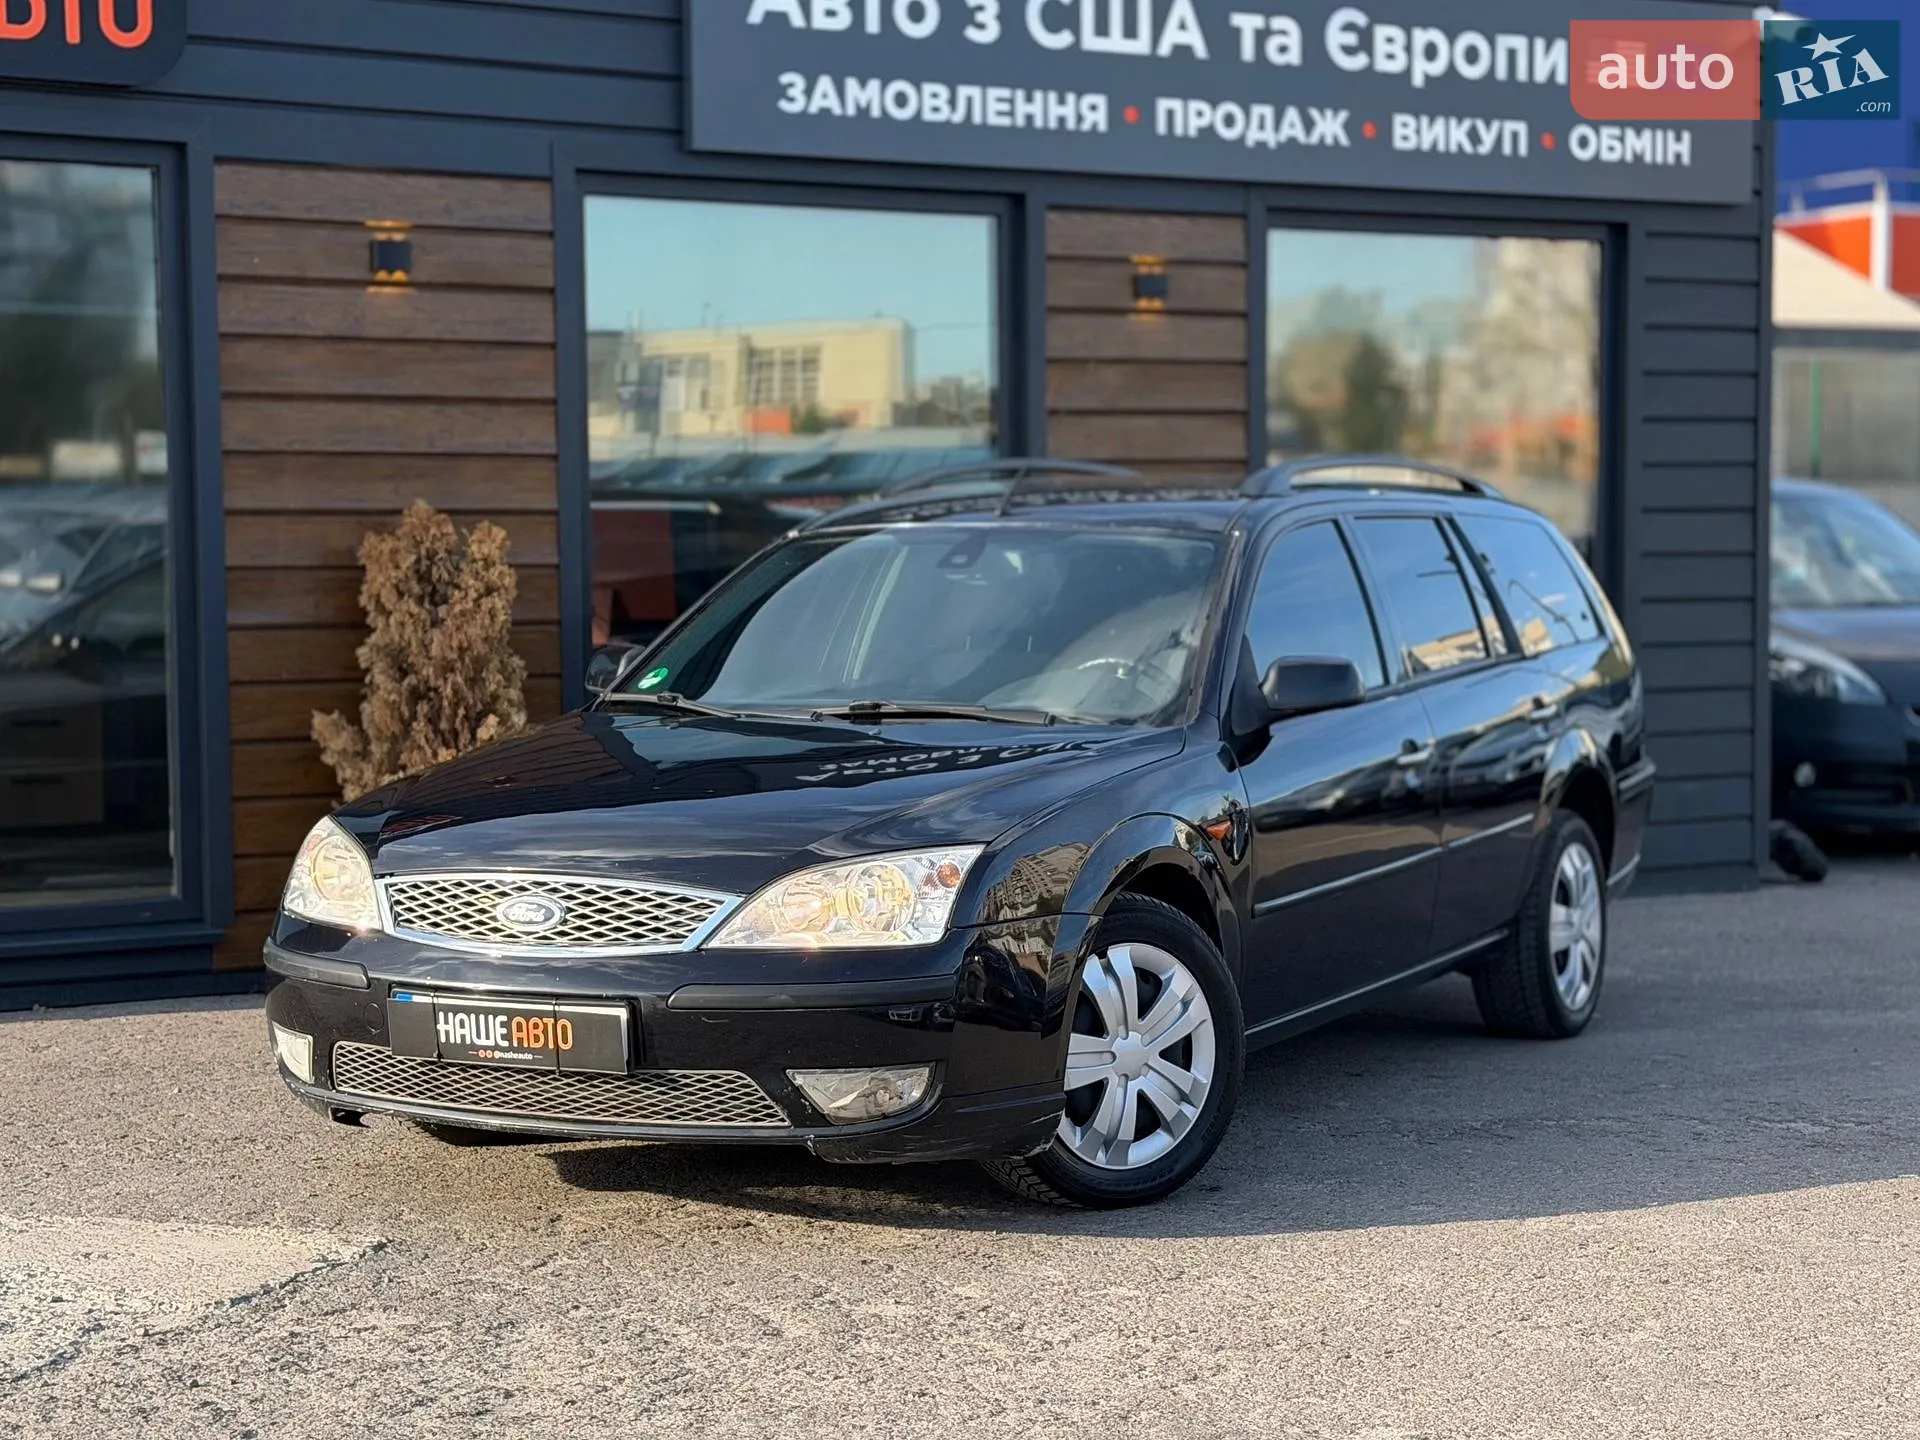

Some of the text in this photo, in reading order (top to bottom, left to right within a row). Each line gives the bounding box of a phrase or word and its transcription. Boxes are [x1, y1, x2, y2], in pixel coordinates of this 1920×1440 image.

[1025, 0, 1209, 60] США
[1230, 12, 1303, 67] та
[1324, 7, 1568, 88] Європи
[777, 72, 1692, 166] ЗАМОВЛЕННЯ ПРОДАЖ ВИКУП ОБМІН
